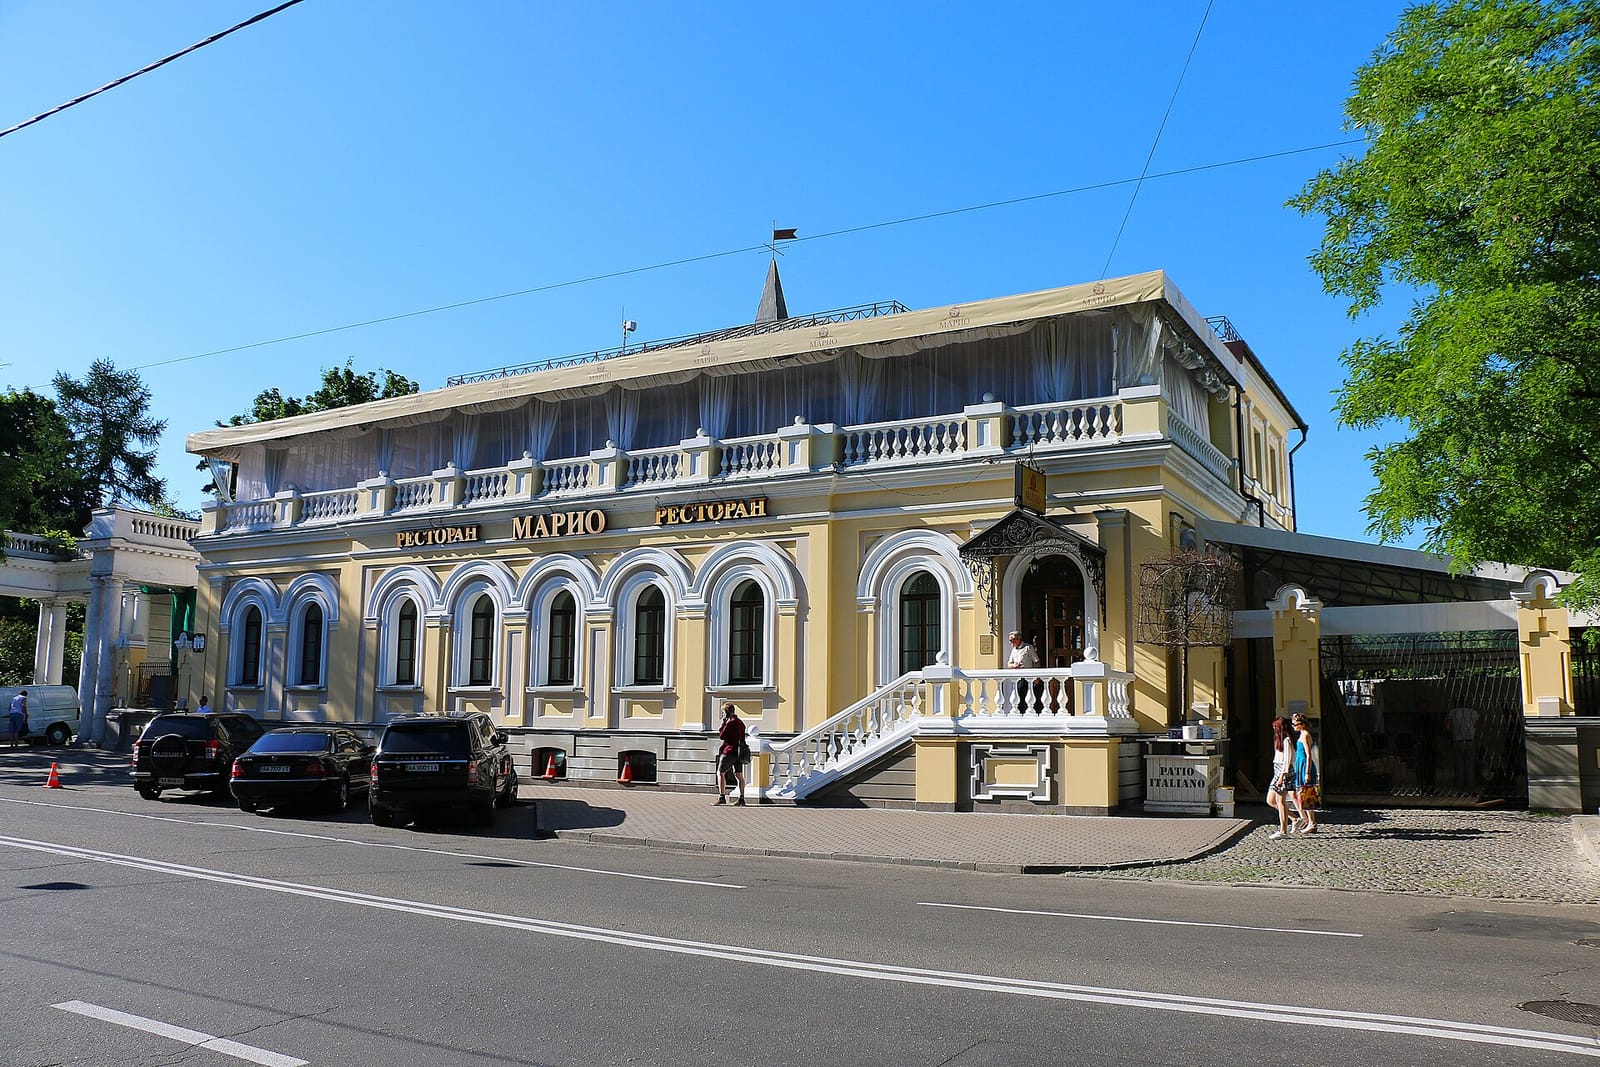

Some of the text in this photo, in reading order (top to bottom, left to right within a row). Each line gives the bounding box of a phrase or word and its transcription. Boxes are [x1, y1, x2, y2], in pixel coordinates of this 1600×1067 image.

[655, 497, 767, 526] РЕСТОРАН
[395, 525, 479, 548] РЕСТОРАН
[511, 509, 607, 541] МАРИО
[1160, 766, 1195, 776] PATIO
[1149, 778, 1206, 788] ITALIANO
